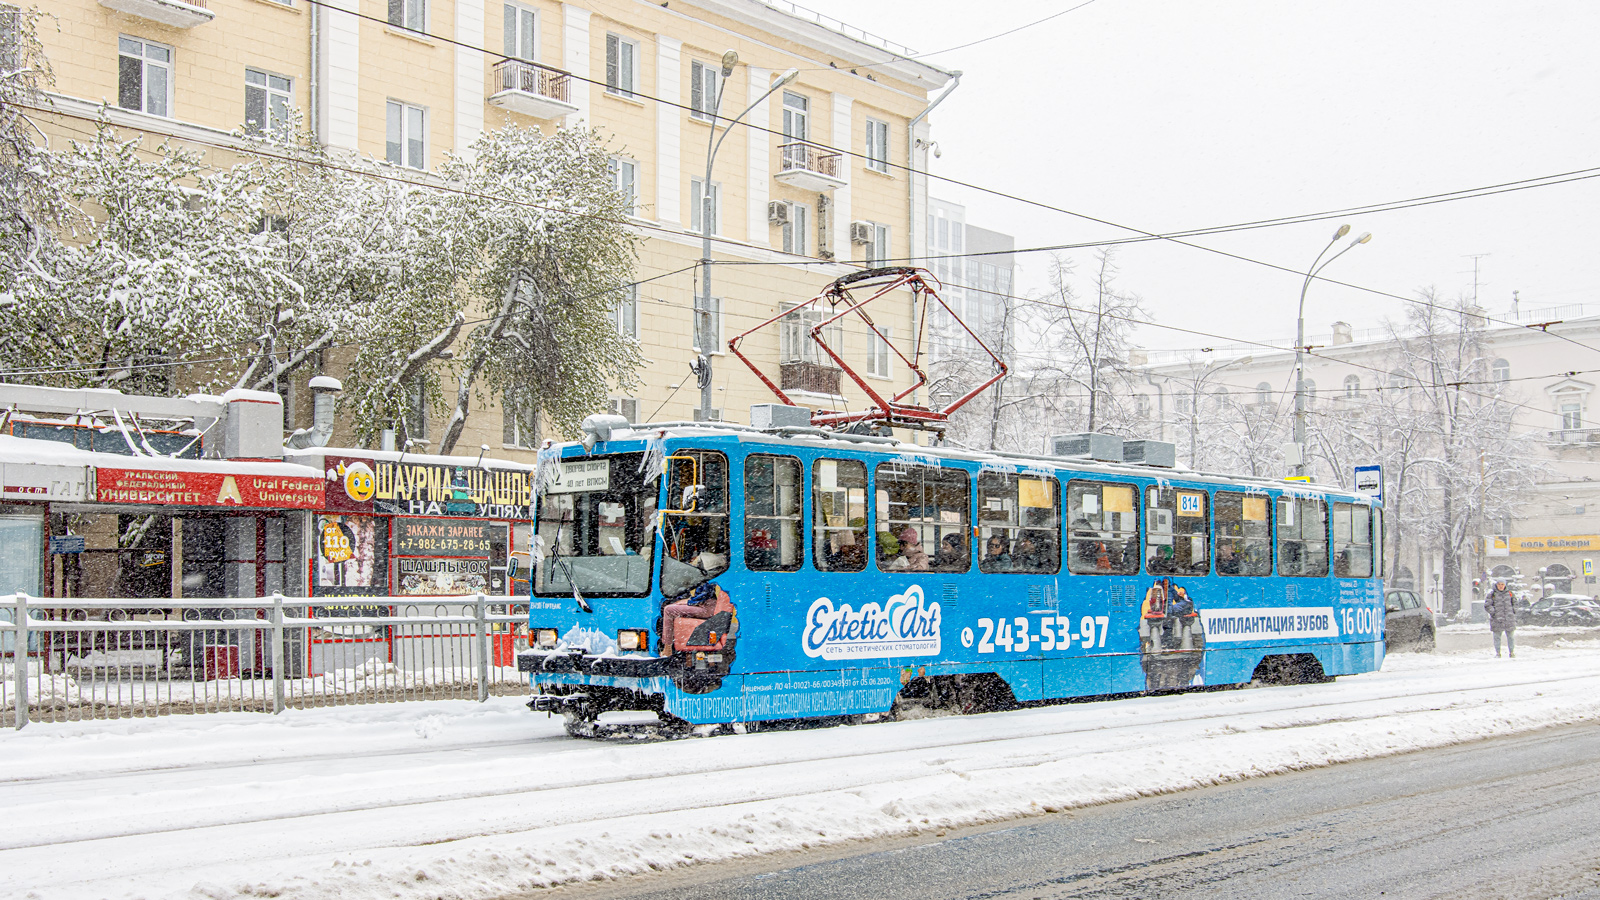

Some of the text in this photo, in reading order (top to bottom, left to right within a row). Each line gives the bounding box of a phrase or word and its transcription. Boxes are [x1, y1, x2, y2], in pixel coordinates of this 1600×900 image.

[124, 471, 178, 480] УРАЛЬСКИЙ
[116, 480, 186, 490] ФЕДЕРАЛЬНЫЙ
[253, 478, 324, 491] Ural Federal
[375, 463, 531, 506] ШАУРМА ШАШЛЫ
[567, 479, 574, 488] 40
[99, 488, 201, 503] УНИВЕРСИТЕТ
[259, 490, 319, 505] University
[409, 500, 442, 515] НА
[1182, 496, 1198, 510] 814
[406, 524, 483, 538] ЗАКАЖИ ЗАРАНЕЕ
[325, 535, 350, 549] 110
[399, 538, 491, 551] +7-982-675-28-65
[329, 549, 348, 560] руб.
[401, 559, 488, 574] ШАШЛЫЧОК
[807, 603, 938, 650] Estetic Art
[1208, 614, 1329, 636] ИМПЛАНТАЦИЯ ЗУБОВ
[1340, 607, 1354, 635] 16
[977, 615, 1110, 654] 243-53-97
[825, 641, 938, 654] сеть эстетических стоматологий
